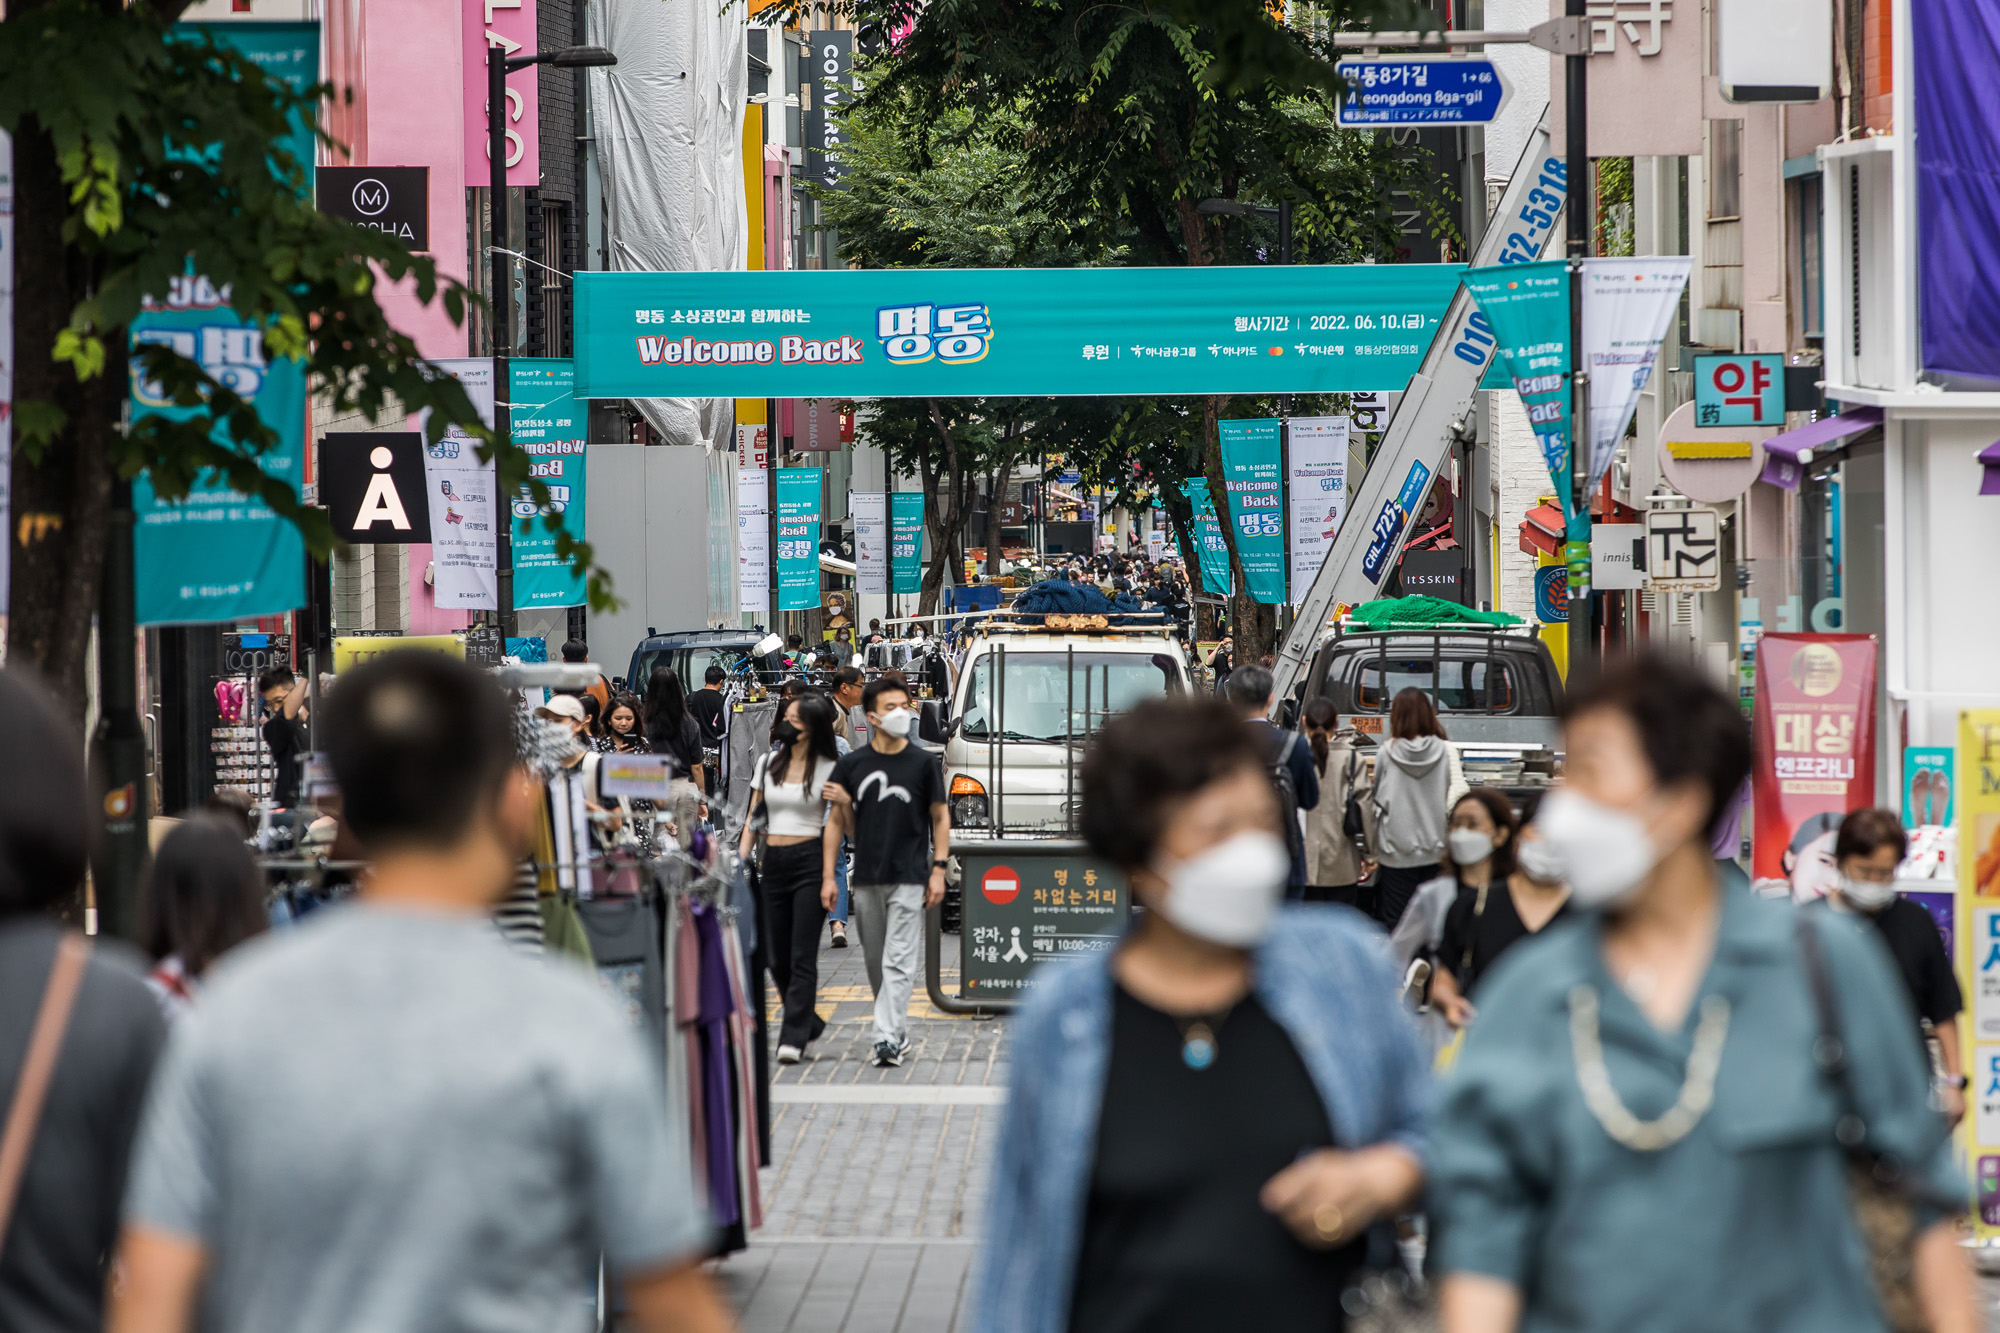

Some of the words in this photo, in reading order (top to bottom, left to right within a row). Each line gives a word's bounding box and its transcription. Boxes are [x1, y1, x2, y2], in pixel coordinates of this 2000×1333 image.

[1342, 65, 1428, 87] 명동8가길
[823, 44, 840, 163] CONVERSE
[1346, 90, 1432, 106] Meongdong
[1435, 90, 1482, 107] 8ga-gil
[636, 310, 665, 323] 명동
[670, 309, 746, 324] 소상공인과
[751, 309, 811, 323] 함께하는
[1234, 316, 1290, 332] 행사기간
[1310, 316, 1350, 330] 2022.
[1354, 315, 1376, 330] 06.
[1380, 314, 1424, 330] 10.(금)
[875, 302, 994, 364] 명동
[637, 334, 775, 365] Welcome
[781, 334, 864, 365] Back
[1082, 345, 1110, 360] 후원
[1146, 347, 1196, 358] 하나금융그룹
[1222, 346, 1258, 357] 하나카드
[1310, 346, 1344, 356] 하나은행
[1355, 344, 1418, 356] 명동상인협의회
[1713, 360, 1770, 422] 약
[1226, 480, 1278, 493] Welcome
[1320, 478, 1343, 492] 명동
[1242, 494, 1280, 508] Back
[1238, 512, 1281, 538] 명동
[1776, 714, 1854, 754] 대상
[1775, 757, 1855, 779] 엔프라니
[1033, 888, 1116, 905] 차없는거리
[972, 926, 1004, 944] 걷자,
[1033, 938, 1054, 952] 매일
[972, 946, 999, 963] 서울
[979, 979, 1014, 989] 서울특별시
